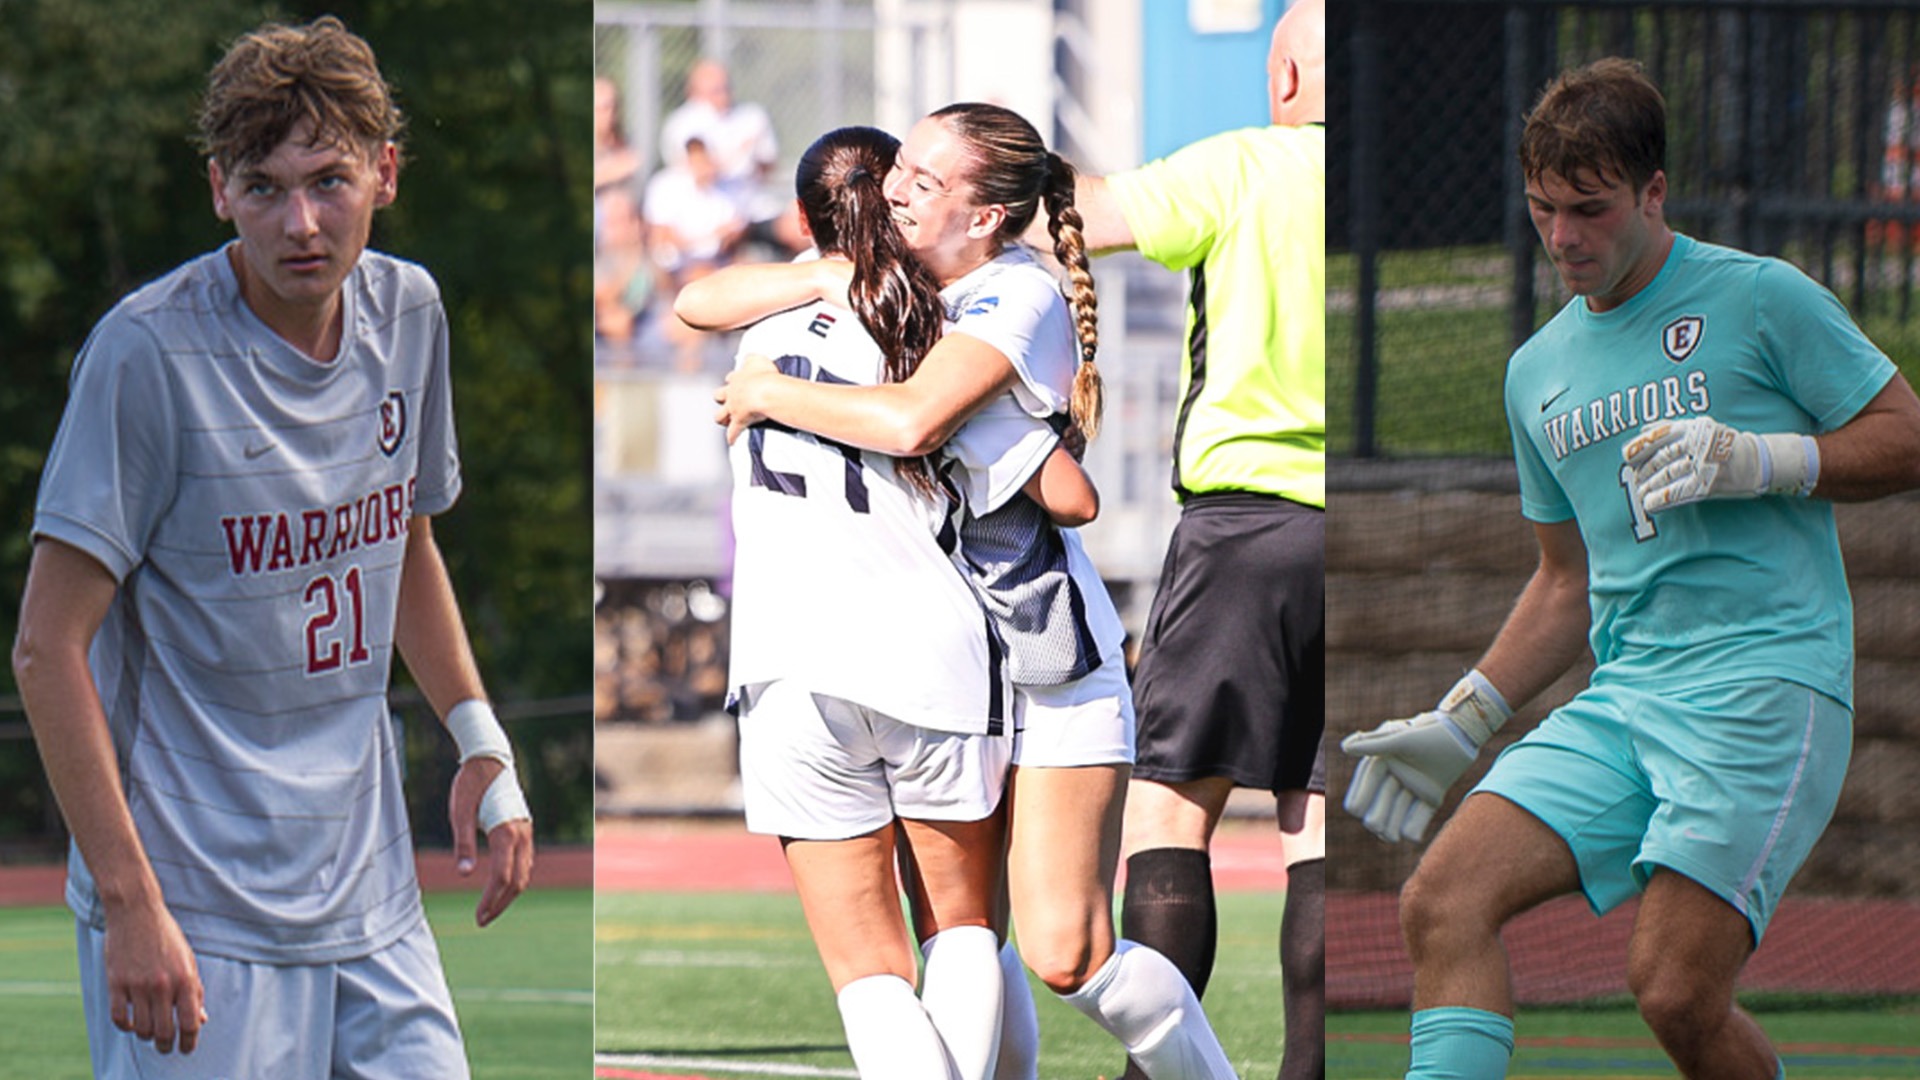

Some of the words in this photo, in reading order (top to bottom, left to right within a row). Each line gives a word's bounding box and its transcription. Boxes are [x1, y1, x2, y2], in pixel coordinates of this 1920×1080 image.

[807, 312, 836, 338] E
[1673, 325, 1690, 351] E
[1544, 371, 1711, 461] WARRIORS
[1619, 462, 1657, 542] 1
[304, 567, 369, 674] 21
